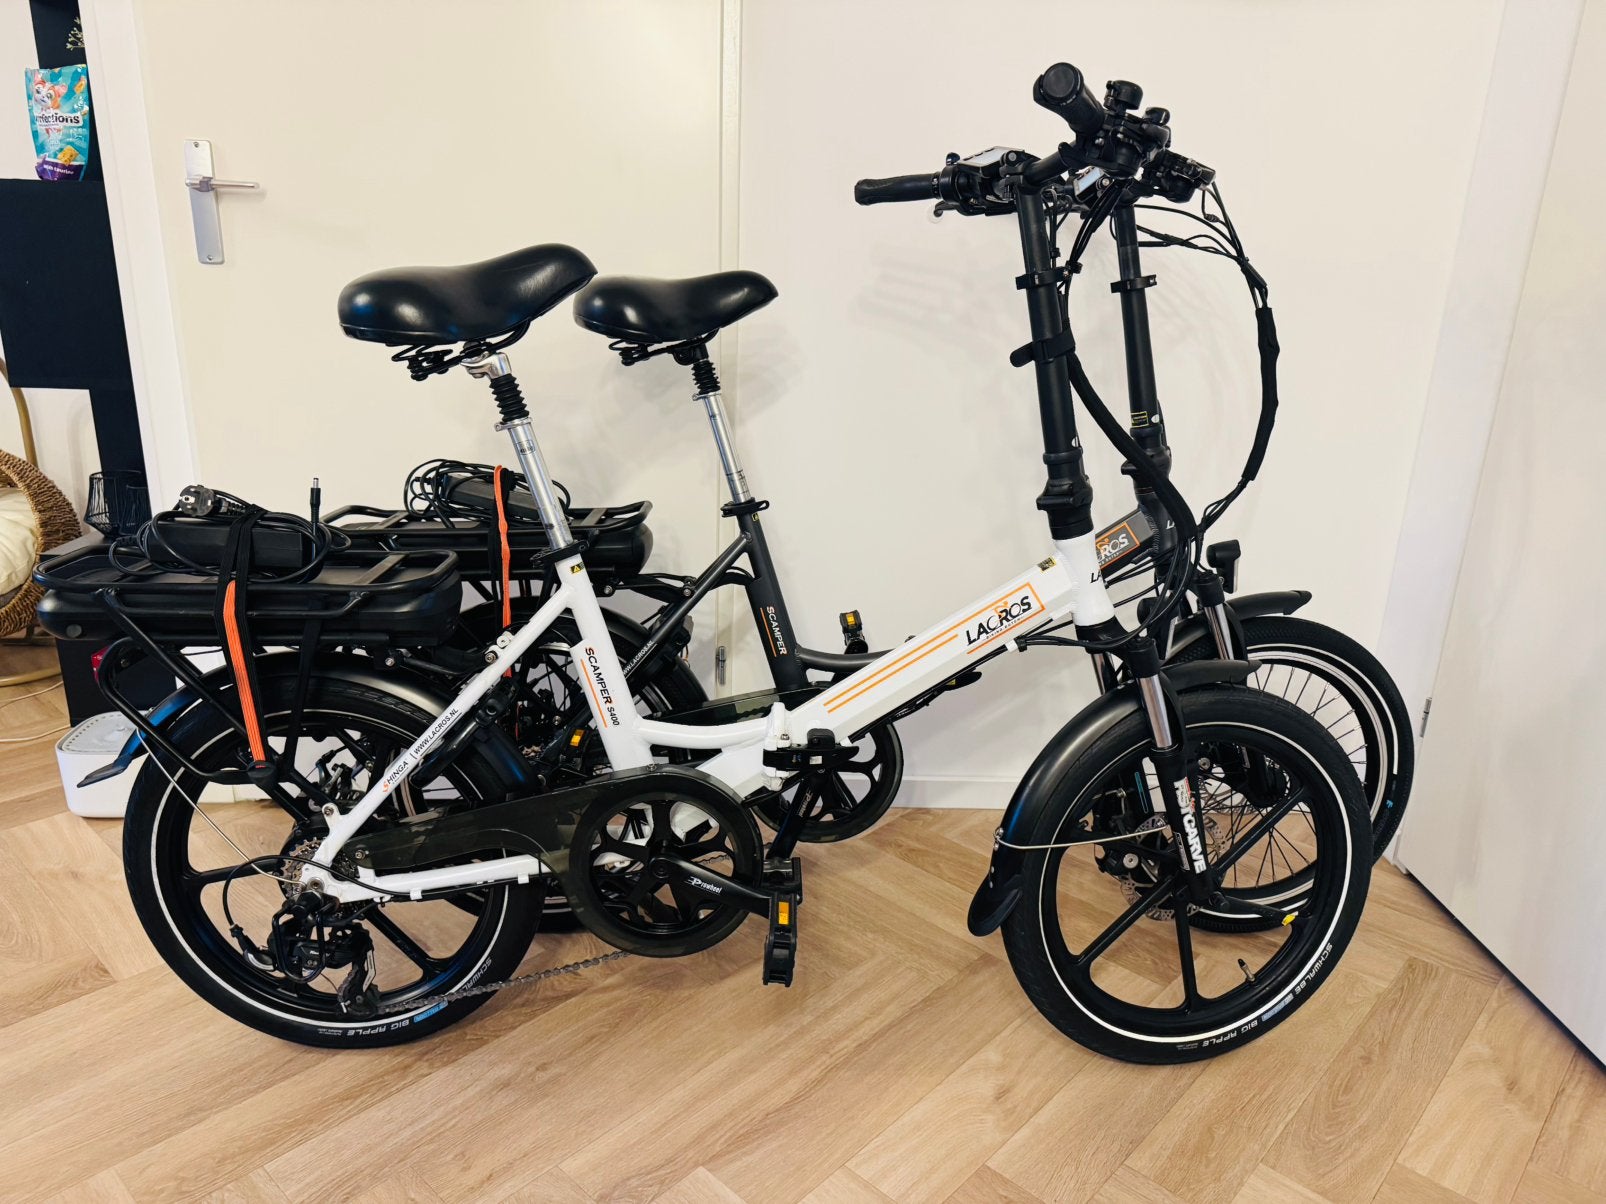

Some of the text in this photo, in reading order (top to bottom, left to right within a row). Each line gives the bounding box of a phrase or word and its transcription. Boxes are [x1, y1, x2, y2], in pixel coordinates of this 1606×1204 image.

[766, 605, 787, 655] SCAMPER
[965, 595, 1033, 646] LACROS
[585, 647, 620, 726] SCAMPER S400
[413, 708, 459, 755] WWW.LACROS.NL
[688, 876, 723, 894] Prowheel
[461, 956, 493, 992] SCHWAL
[1294, 942, 1333, 994] SCHWALBE
[346, 1024, 387, 1036] APPLE
[390, 1019, 410, 1031] BIG
[1201, 1030, 1238, 1048] APPLE
[1240, 1019, 1258, 1033] BIG
